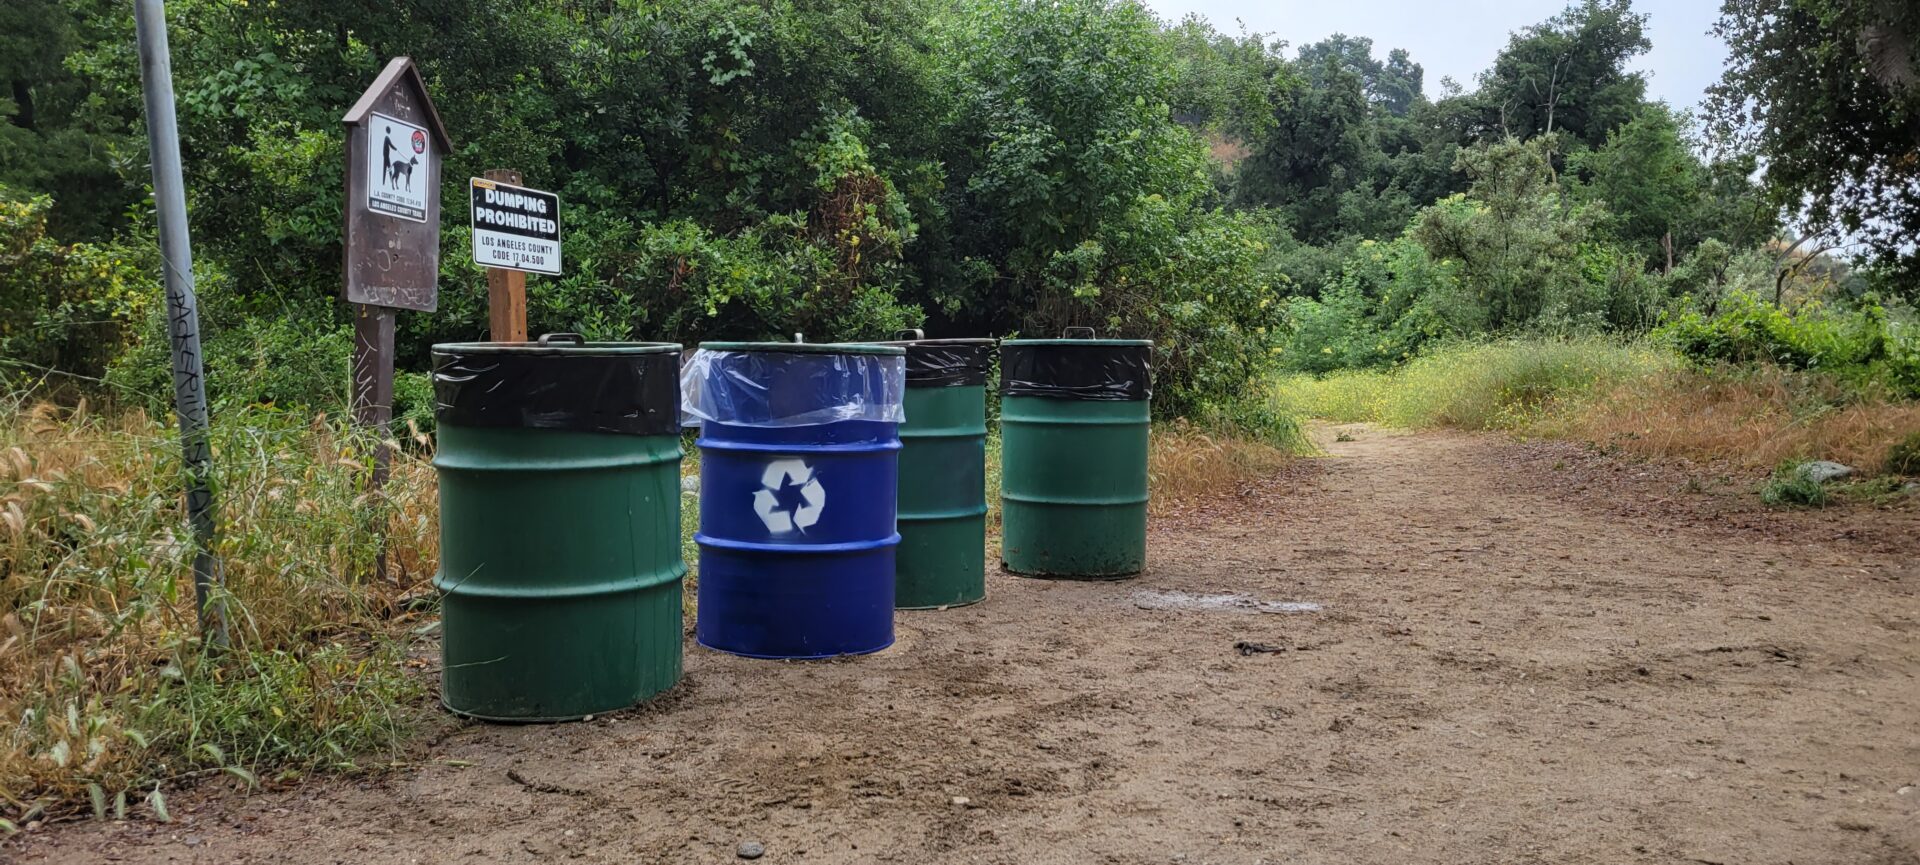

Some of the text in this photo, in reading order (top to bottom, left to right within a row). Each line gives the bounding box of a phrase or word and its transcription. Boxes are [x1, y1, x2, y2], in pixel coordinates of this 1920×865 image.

[371, 200, 380, 208] LOS
[380, 202, 397, 212] ANGELES
[397, 205, 412, 215] COUNTY
[485, 189, 547, 214] DUMPING
[476, 207, 556, 234] PROHIBITED
[482, 236, 553, 255] LOS ANGELES COUNTY
[492, 249, 545, 266] CODE 17.04.500
